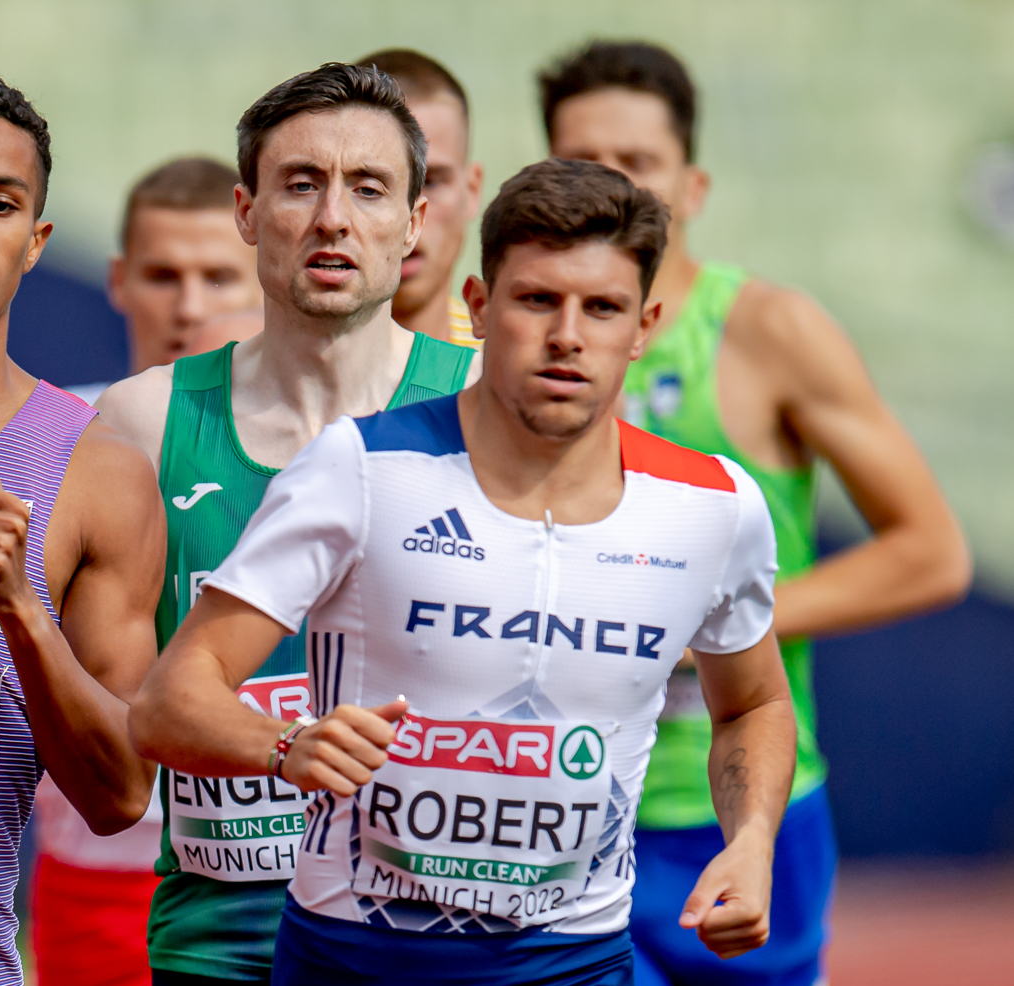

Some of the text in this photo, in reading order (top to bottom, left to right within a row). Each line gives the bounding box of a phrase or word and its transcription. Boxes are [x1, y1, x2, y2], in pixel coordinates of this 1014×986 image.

[403, 536, 485, 561] adidas
[596, 552, 687, 570] Crédit Mutuel
[405, 600, 666, 660] FRANCE
[387, 721, 551, 771] SPAR
[211, 815, 306, 838] I RUN CLE
[369, 781, 599, 852] ROBERT
[184, 843, 295, 872] MUNICH
[409, 855, 416, 871] I
[421, 857, 468, 878] RUN
[371, 865, 565, 918] MUNICH 2022
